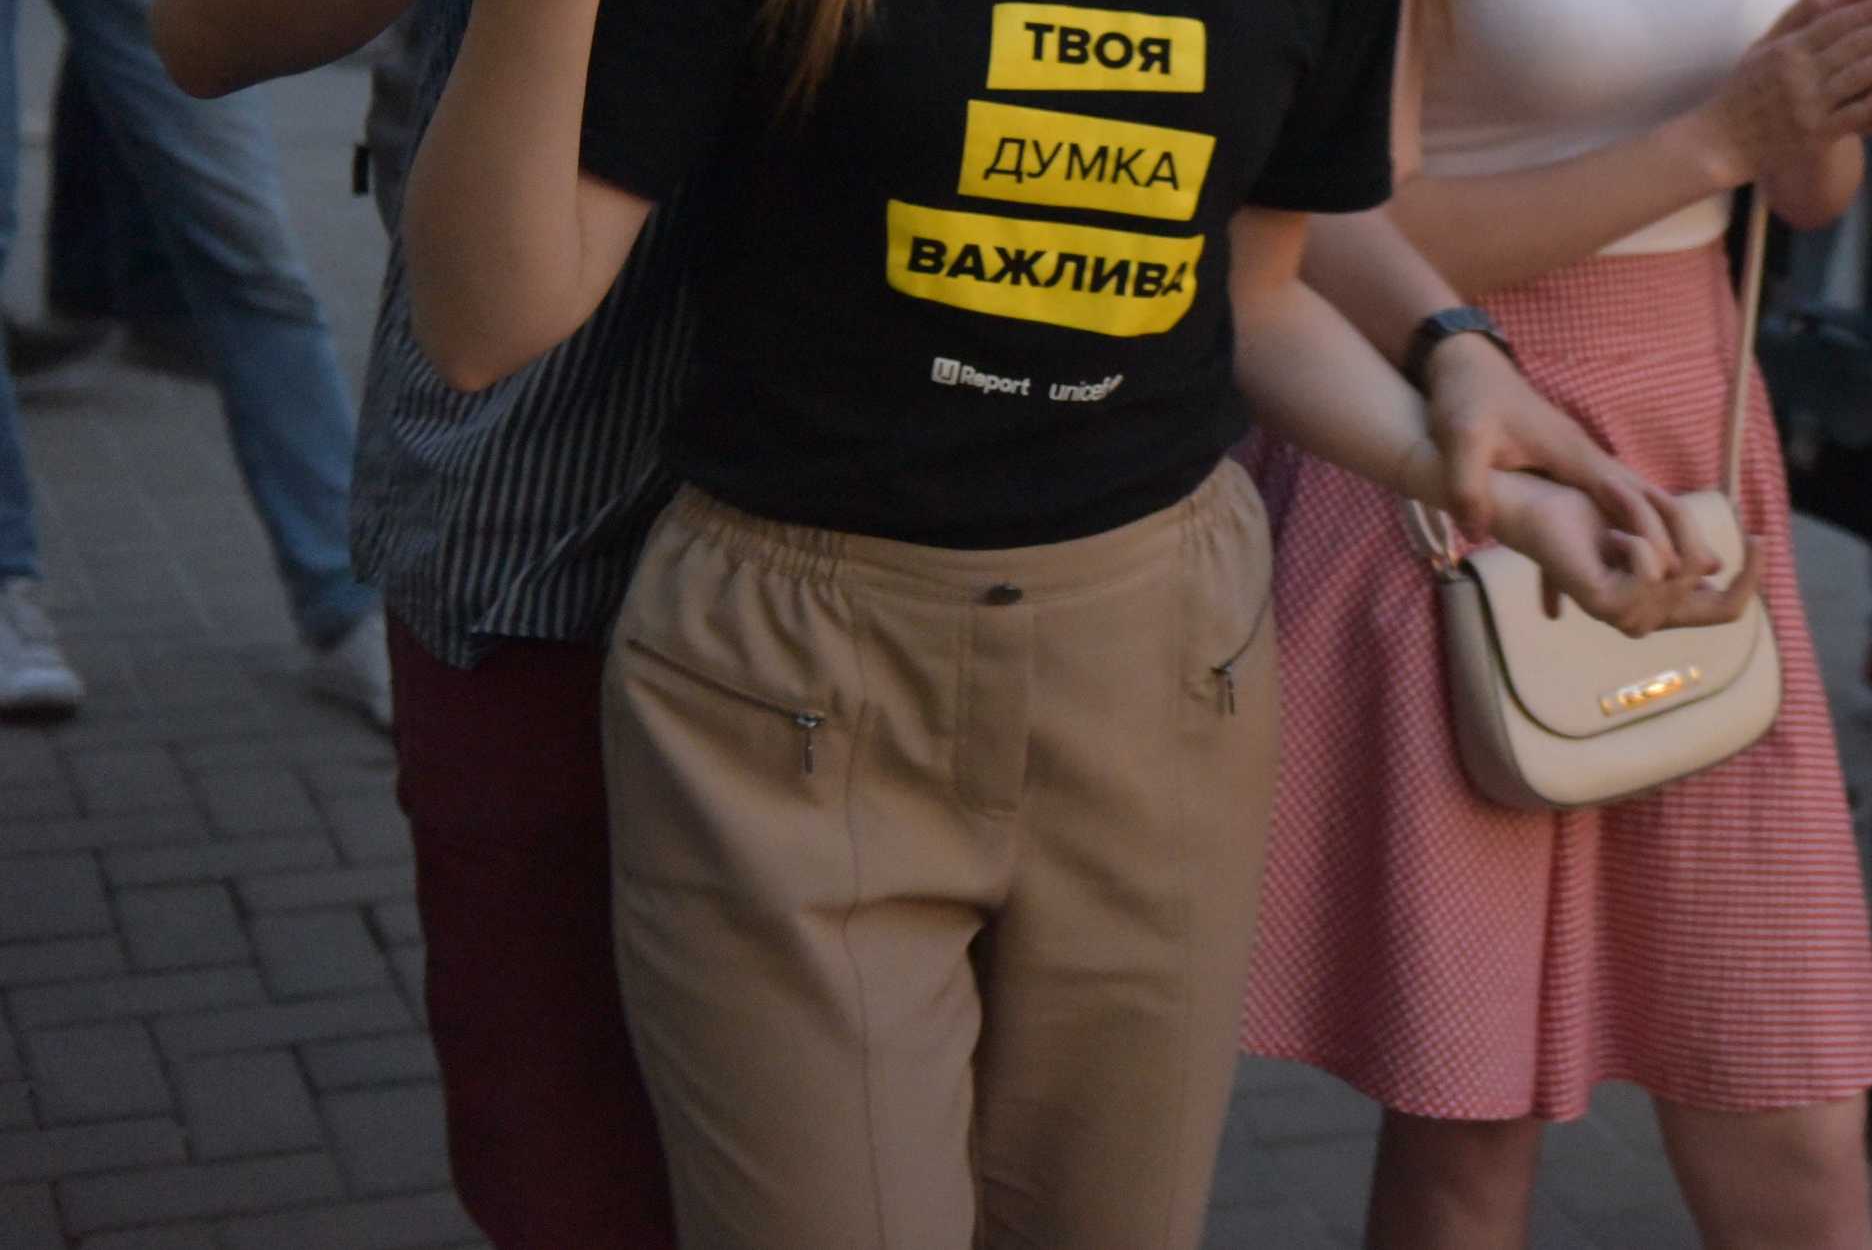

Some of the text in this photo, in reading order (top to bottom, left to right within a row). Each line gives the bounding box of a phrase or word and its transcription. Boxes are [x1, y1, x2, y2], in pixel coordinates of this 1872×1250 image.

[1024, 22, 1171, 74] ТВОЯ
[983, 137, 1180, 191] ДУМКА
[907, 236, 1187, 298] ВАЖЛИВА
